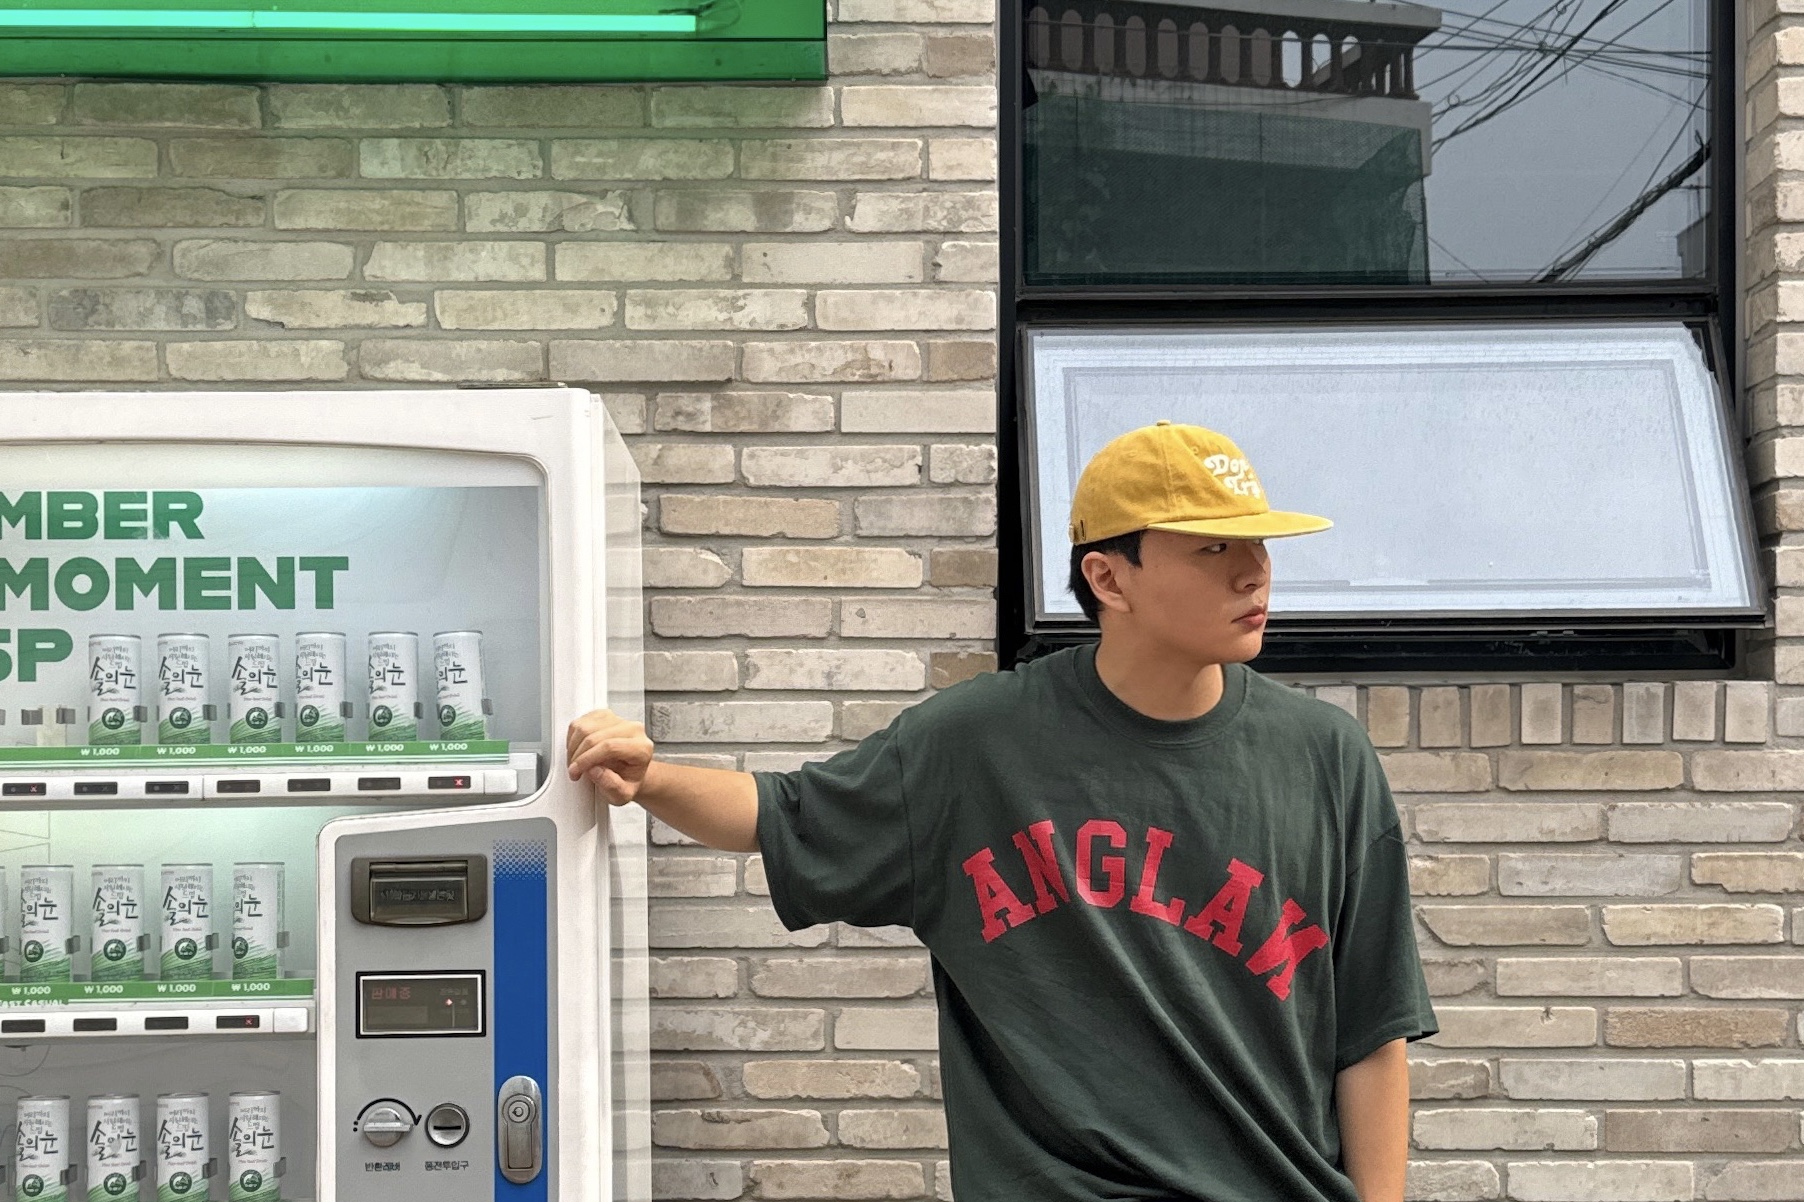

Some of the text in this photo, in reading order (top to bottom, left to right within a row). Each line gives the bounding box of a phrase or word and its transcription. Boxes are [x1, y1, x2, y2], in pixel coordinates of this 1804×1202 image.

[0, 556, 349, 611] MOMENT
[0, 628, 73, 683] P
[168, 747, 196, 755] 1,000
[239, 746, 267, 754] 1,000
[306, 745, 334, 753] 1,000
[377, 744, 404, 752] 1,000
[441, 743, 468, 751] 1,000
[93, 748, 120, 756] 1,000
[962, 819, 1330, 1001] ANGLAN
[23, 986, 51, 995] 1,000
[96, 986, 123, 994] 1,000
[169, 985, 196, 993] 1,000
[243, 983, 270, 992] 1,000
